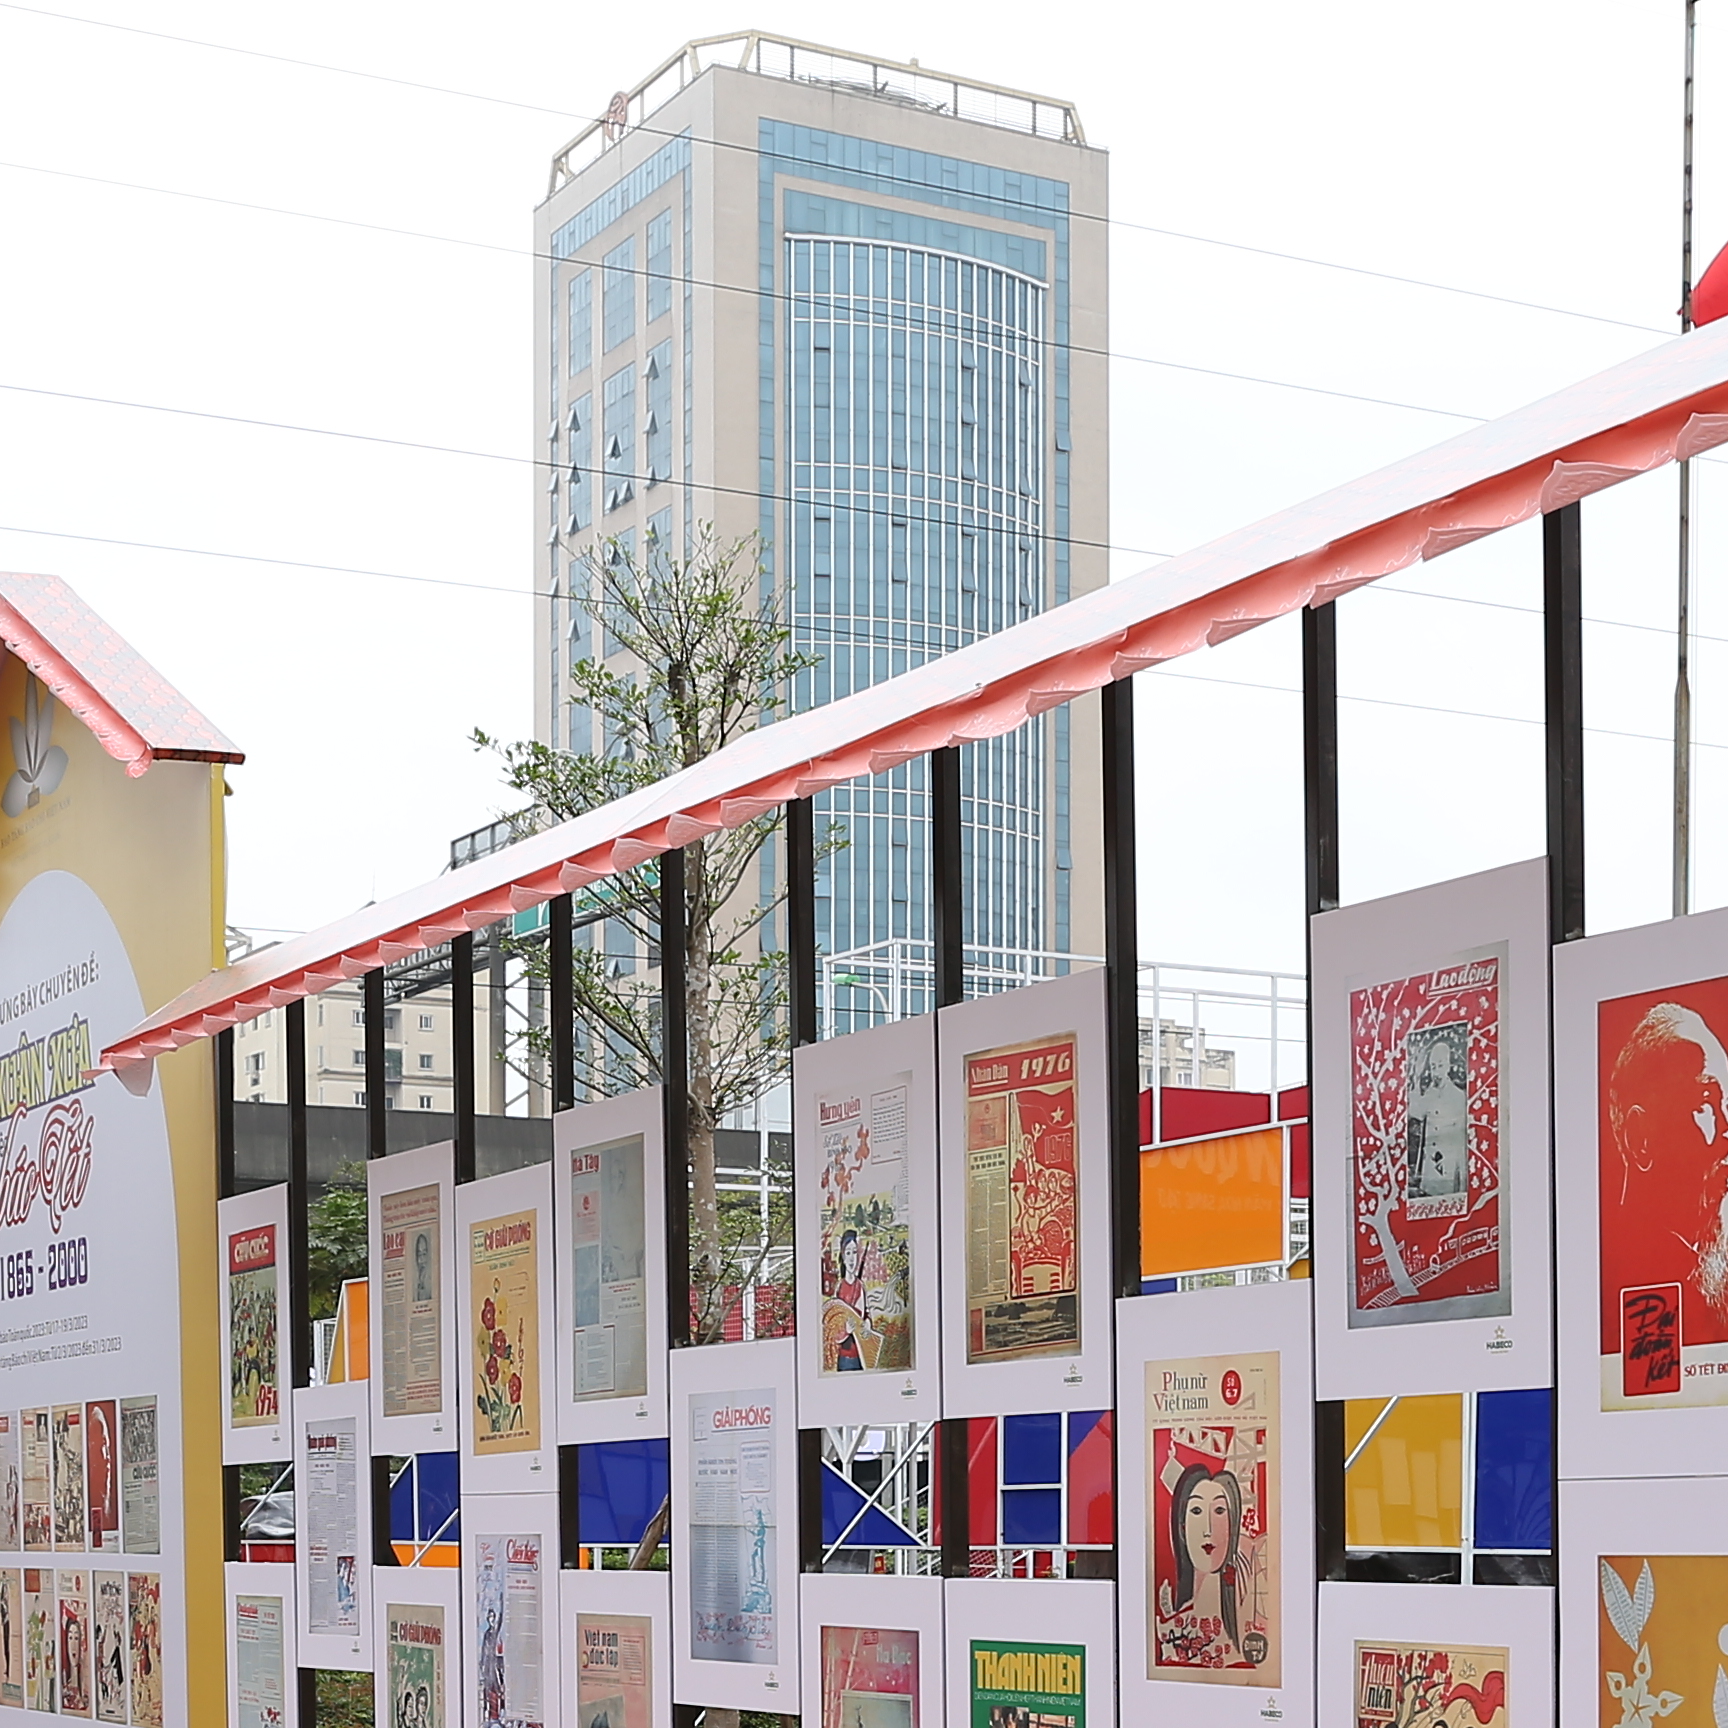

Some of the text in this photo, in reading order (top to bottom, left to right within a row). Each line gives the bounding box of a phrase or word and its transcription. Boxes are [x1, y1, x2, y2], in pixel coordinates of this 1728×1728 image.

[1020, 1051, 1072, 1080] 1976
[47, 1236, 89, 1291] 2000
[1485, 1340, 1513, 1349] HABECO
[1182, 1396, 1209, 1410] nam
[733, 1404, 772, 1427] PHÓNG
